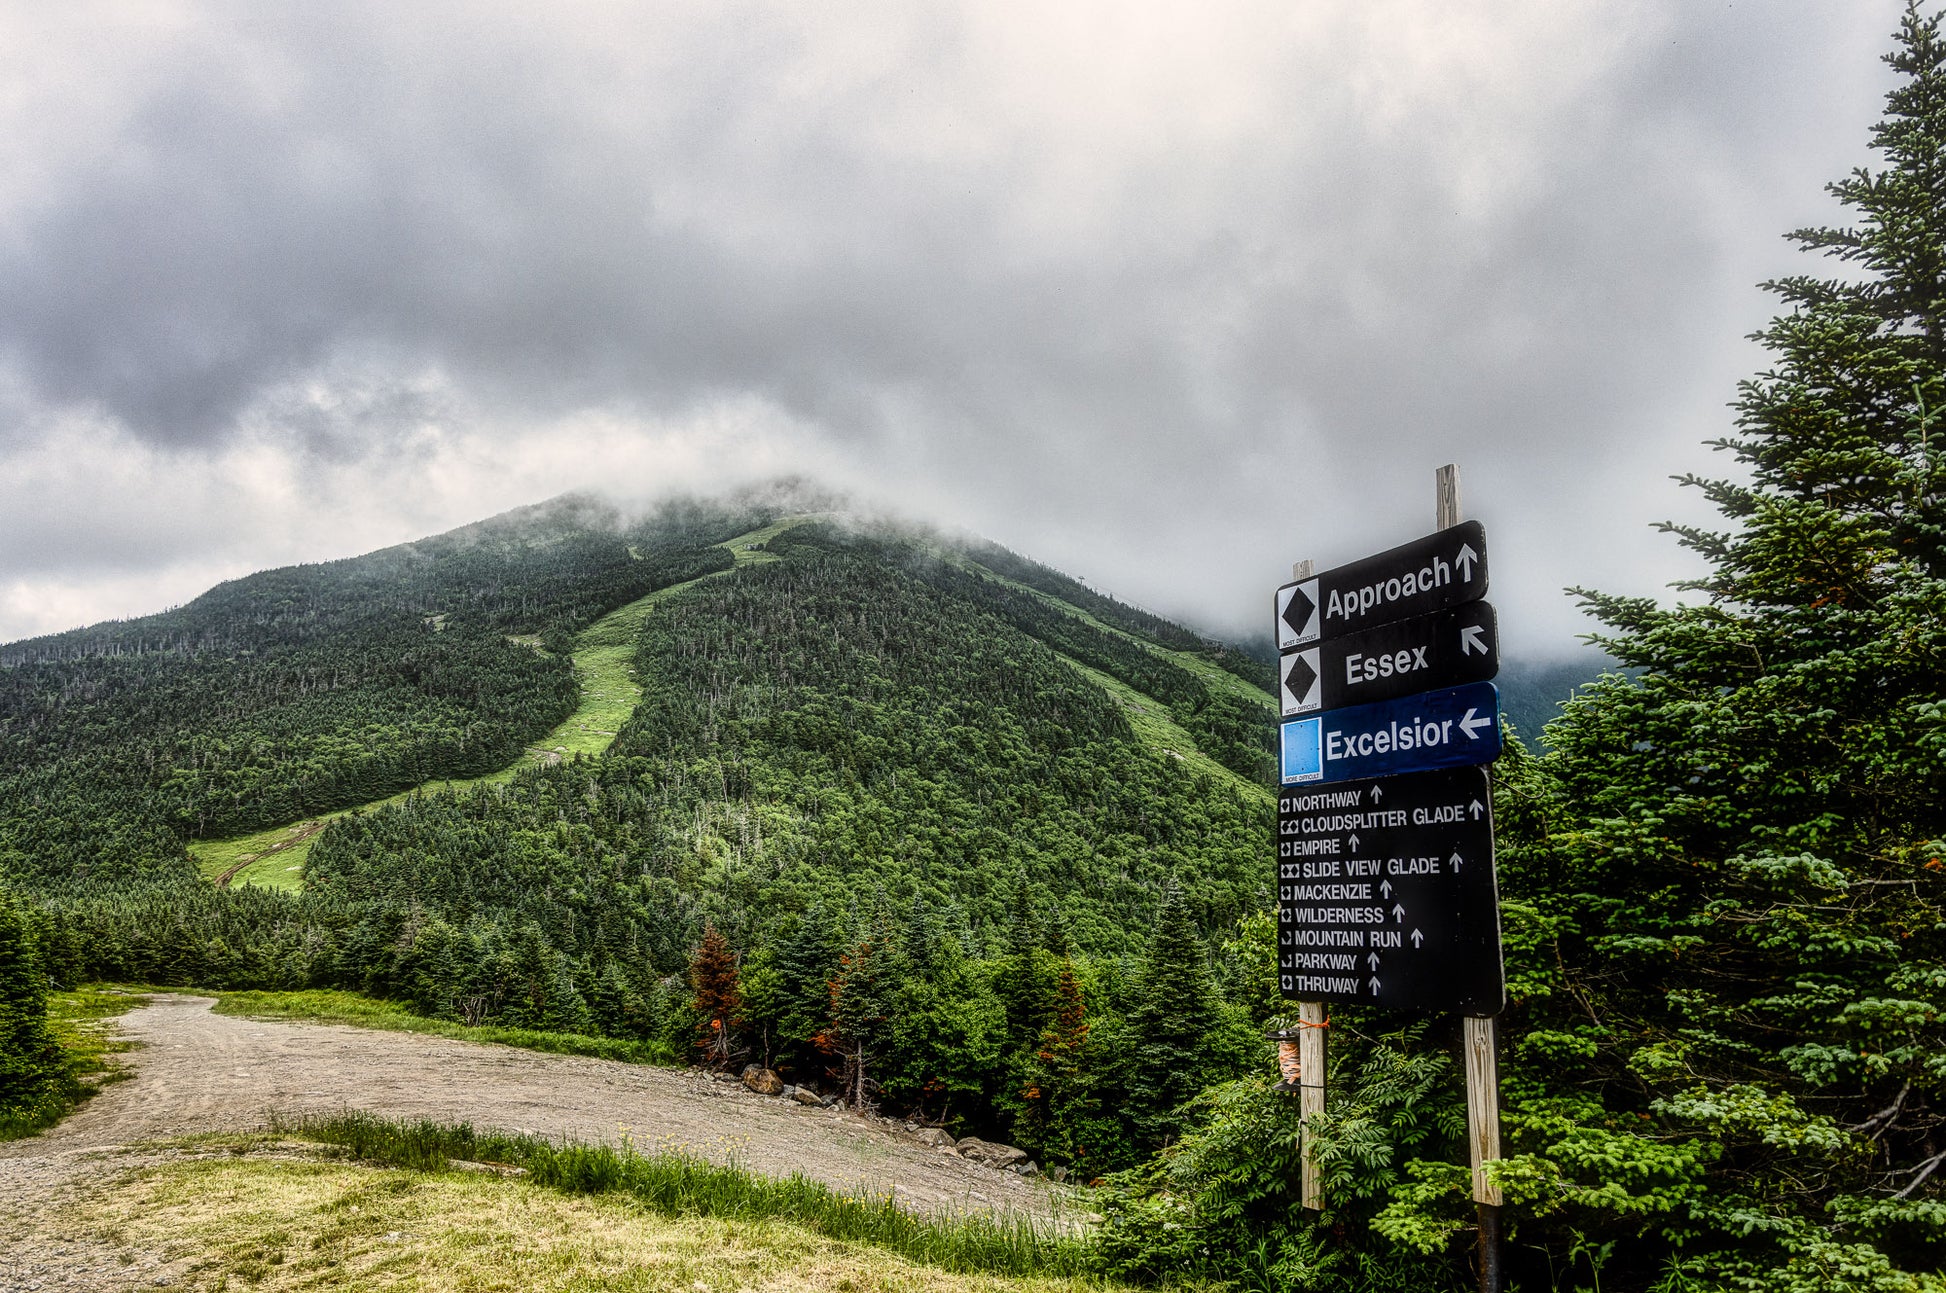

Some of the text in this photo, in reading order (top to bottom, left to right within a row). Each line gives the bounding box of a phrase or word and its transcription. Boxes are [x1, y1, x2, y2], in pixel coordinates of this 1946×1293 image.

[1326, 556, 1450, 621] Approach
[1346, 646, 1429, 685] Essex
[1326, 716, 1453, 761] Excelsior
[1292, 790, 1362, 813] NORTHWAY
[1301, 805, 1466, 834] CLOUDSPLITTER GLADE
[1293, 838, 1341, 856] EMPIRE
[1302, 857, 1440, 878] SLIDE VIEW GLADE
[1294, 884, 1372, 900] MACKENZIE
[1295, 907, 1384, 923] WILDERNESS
[1295, 930, 1401, 947] MOUNTAIN RUN
[1295, 953, 1357, 970] PARKWAY
[1296, 975, 1359, 994] THRUWAY
